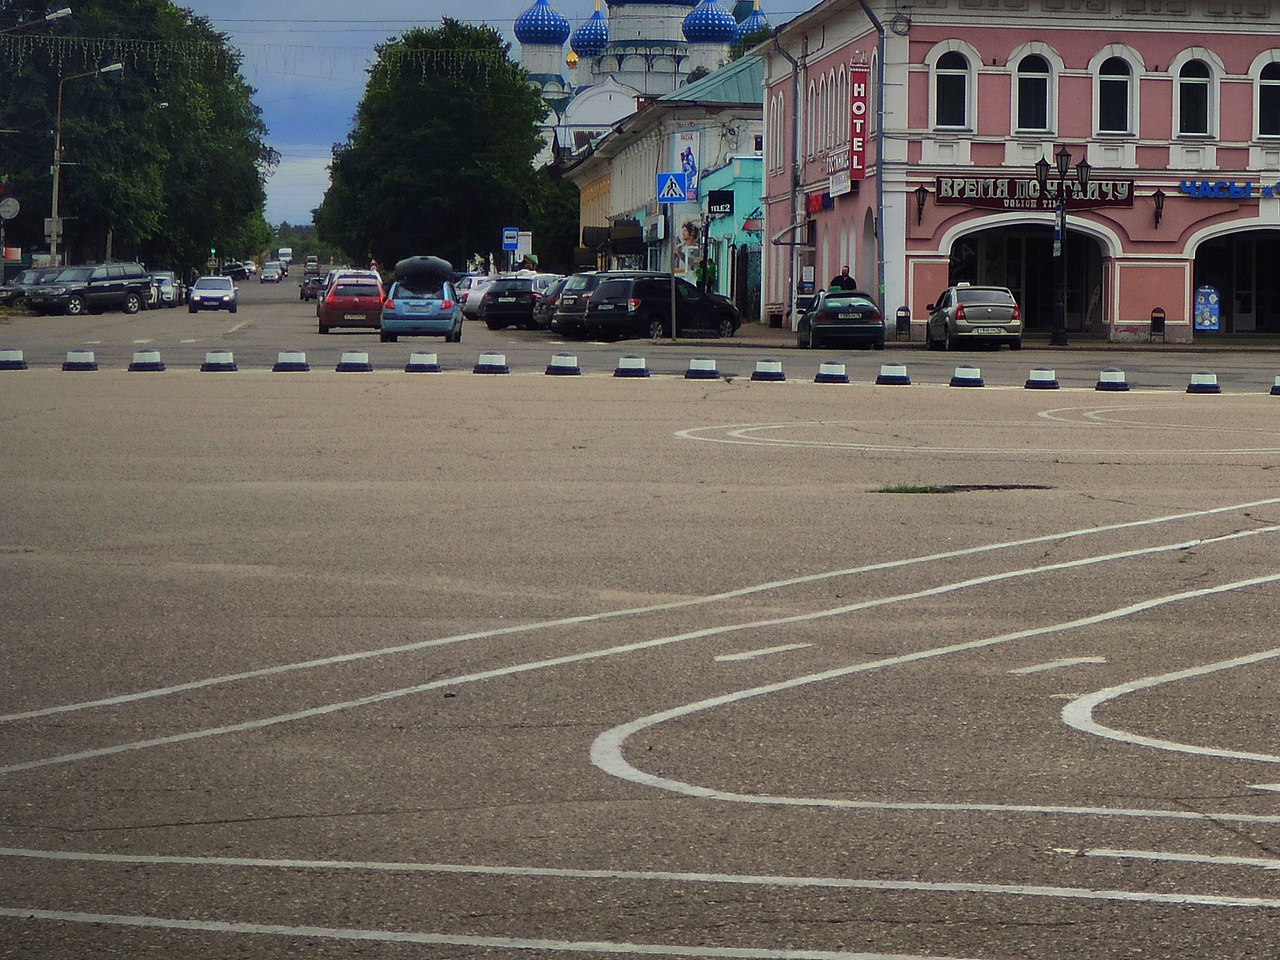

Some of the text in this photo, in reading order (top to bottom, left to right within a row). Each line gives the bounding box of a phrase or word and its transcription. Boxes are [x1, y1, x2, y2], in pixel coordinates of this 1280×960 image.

[852, 83, 866, 169] HOTEL
[939, 178, 1010, 198] ВРЕМЯ
[1014, 179, 1041, 198] ПО
[1180, 180, 1251, 199] ЧАСЫ
[710, 203, 731, 212] TELE2
